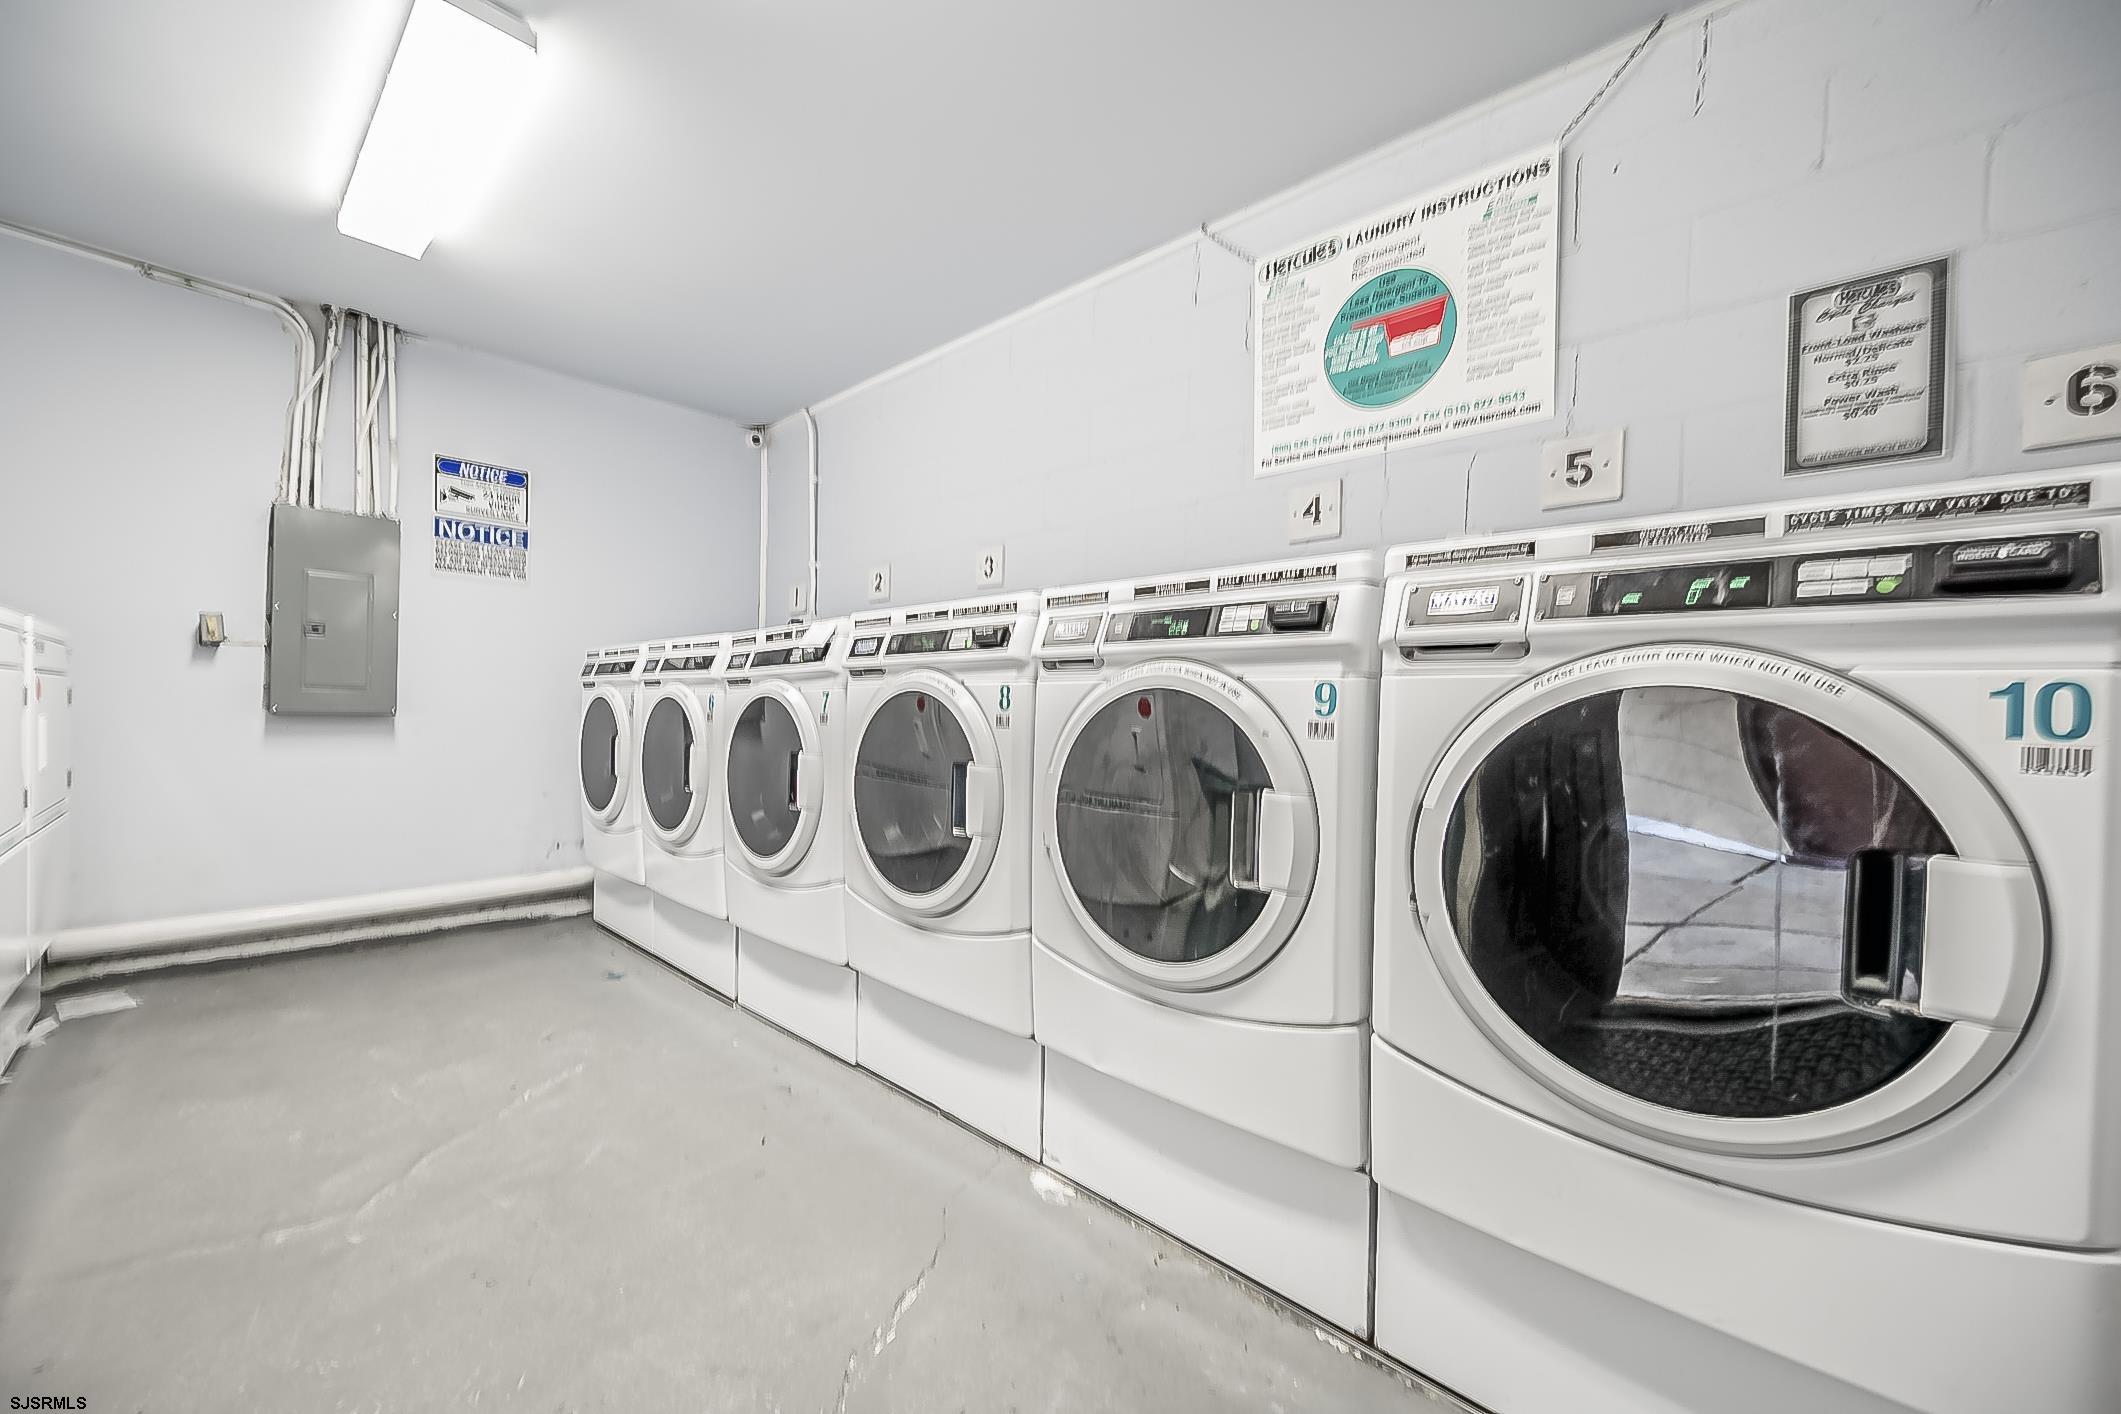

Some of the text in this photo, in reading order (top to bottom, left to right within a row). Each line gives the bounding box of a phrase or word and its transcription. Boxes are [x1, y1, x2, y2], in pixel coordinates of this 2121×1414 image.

[1265, 239, 1337, 281] Hercules
[1346, 208, 1416, 251] LAUNDRY
[1420, 159, 1551, 222] INSTRUCTIONS
[1349, 294, 1370, 311] Less
[1372, 279, 1416, 302] Detergent
[1379, 274, 1397, 289] Use
[1340, 305, 1374, 325] Prevent
[1827, 363, 1899, 385] Extra Rinse
[1823, 392, 1861, 407] Power
[1864, 384, 1900, 401] Wash
[2065, 363, 2119, 417] 6
[458, 461, 509, 485] NOTICE
[1565, 448, 1593, 488] 5
[1303, 494, 1321, 526] 4
[1789, 510, 1840, 528] CYCLE
[1844, 504, 1898, 522] TIMES
[1902, 499, 1938, 515] MAY
[1945, 493, 1992, 510] VARY
[2000, 488, 2037, 505] DUE
[439, 518, 525, 549] NOTICE
[874, 571, 883, 593] 2
[983, 555, 994, 578] 3
[1533, 650, 1849, 699] PLEASE LEAVE DOOR OPEN WHEN NOT IN USE
[823, 691, 830, 714] 7
[999, 684, 1012, 712] 8
[1314, 682, 1338, 717] 9
[1988, 680, 2093, 742] 10
